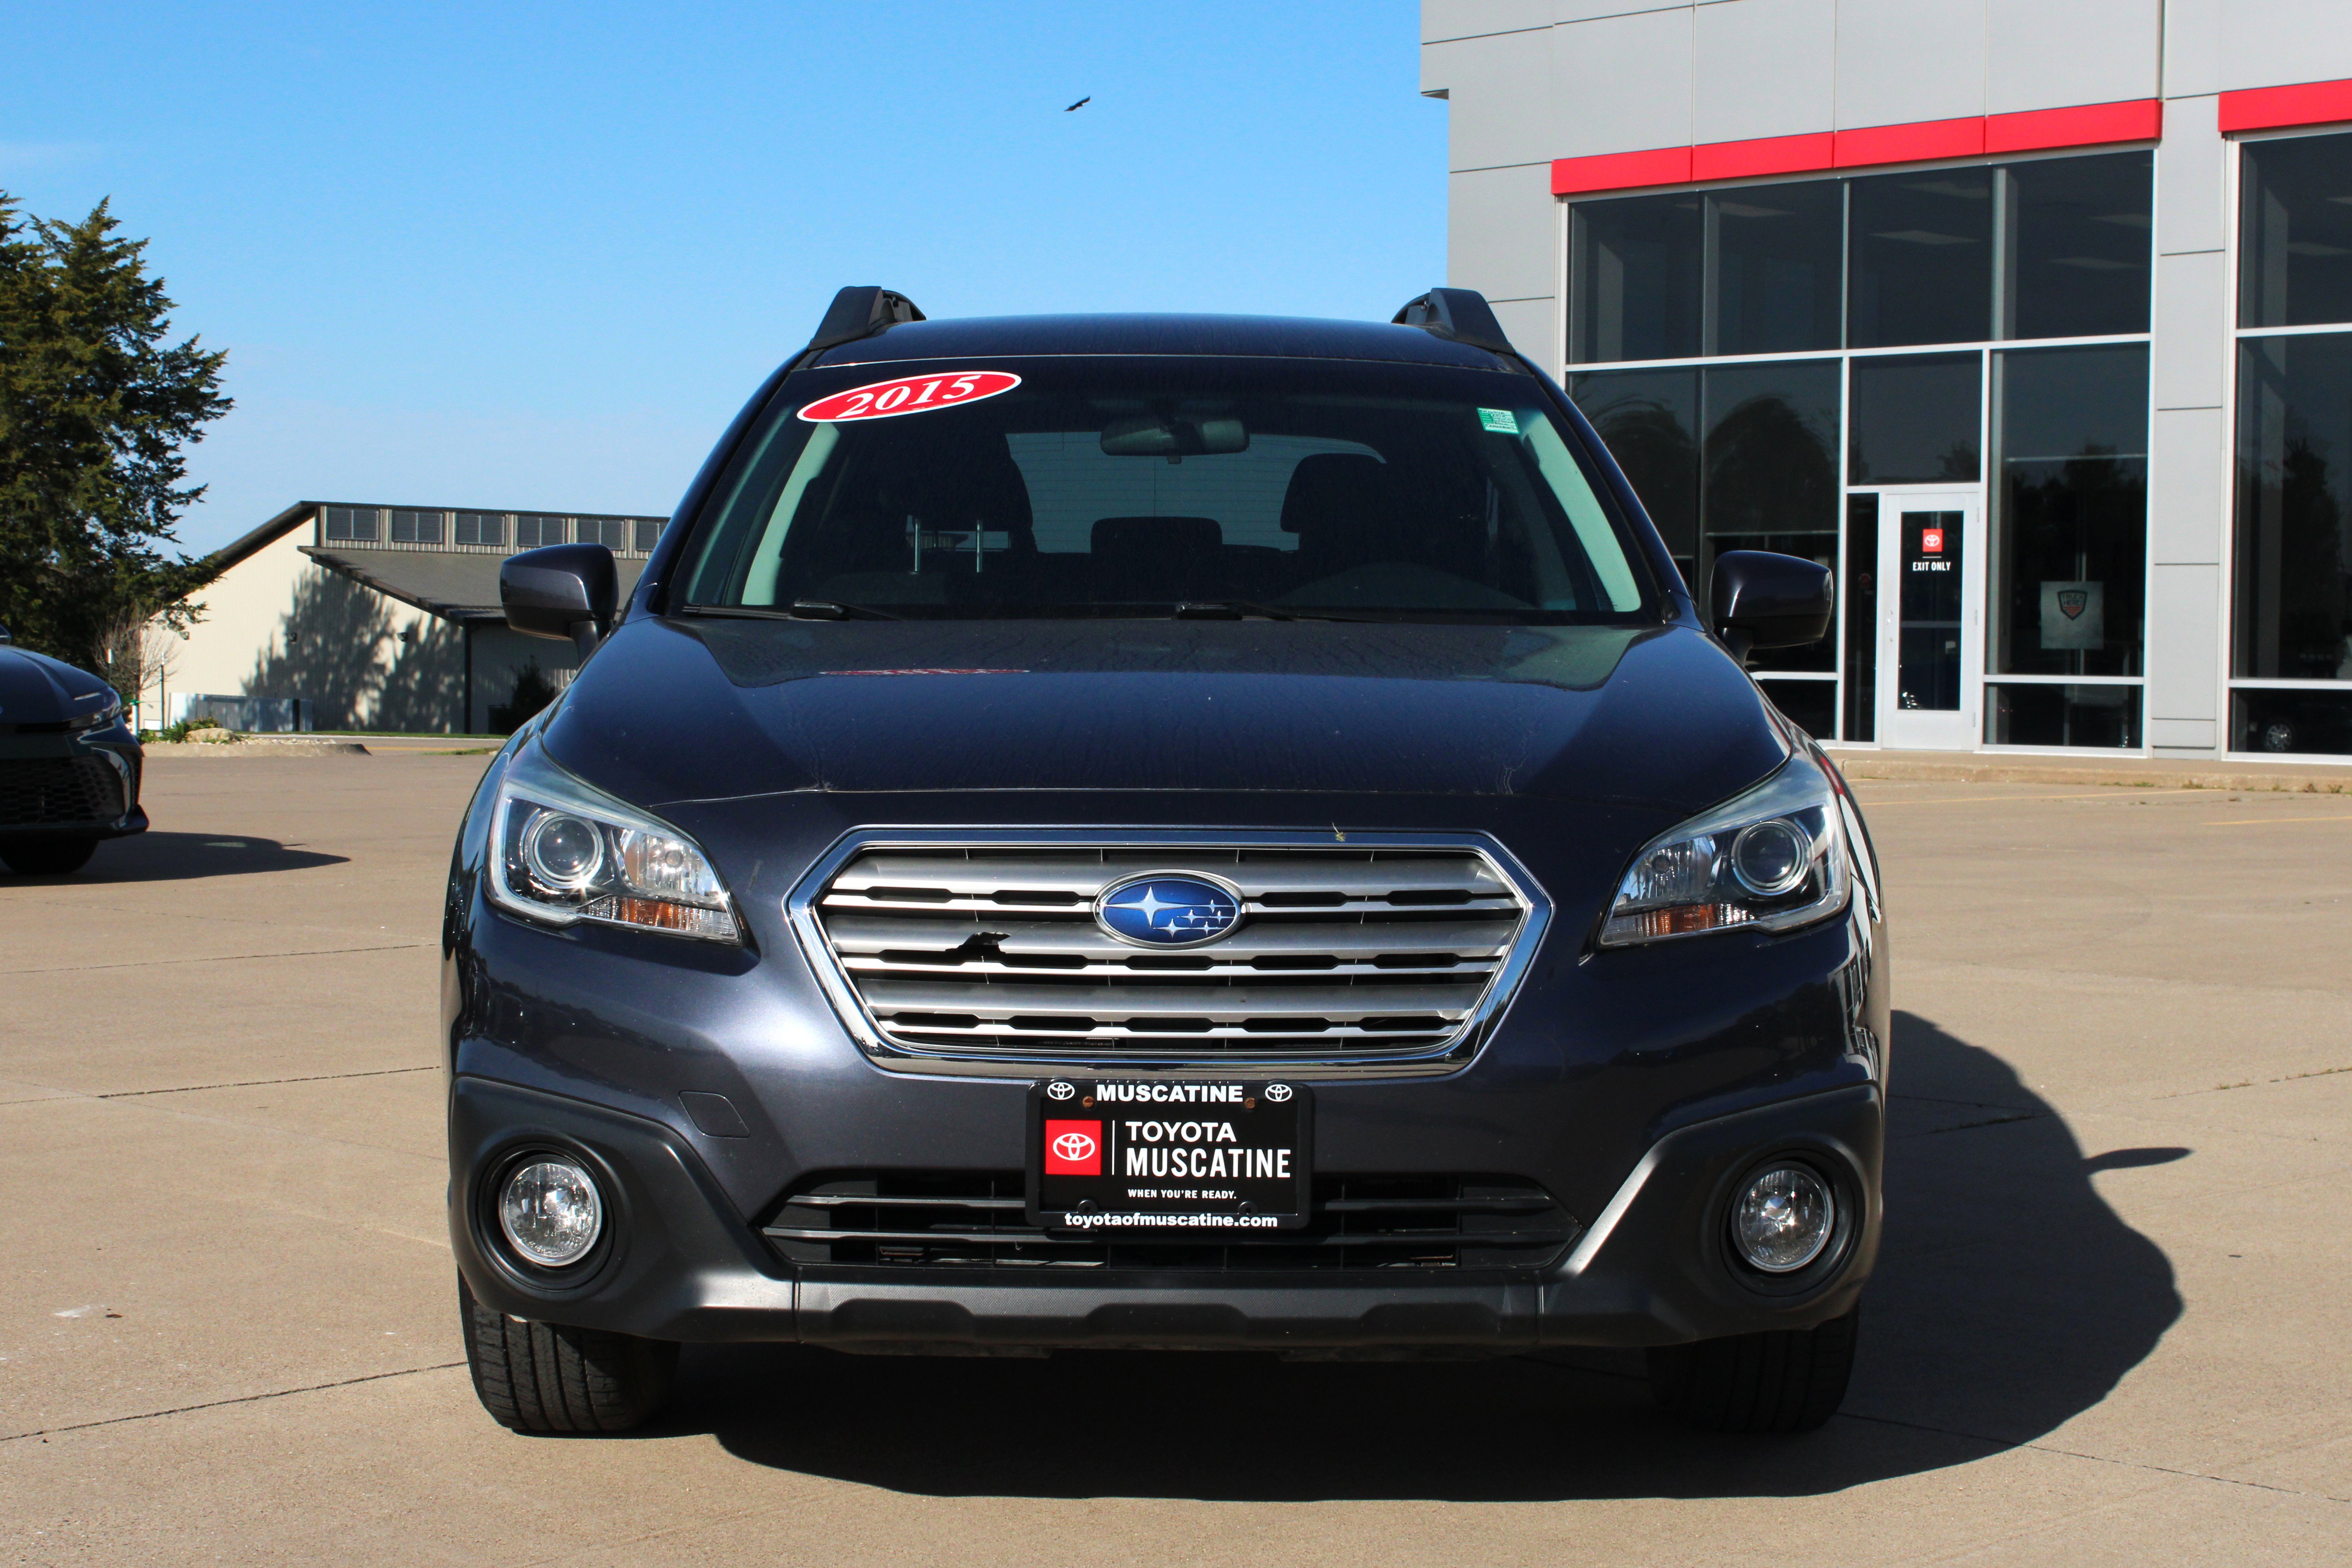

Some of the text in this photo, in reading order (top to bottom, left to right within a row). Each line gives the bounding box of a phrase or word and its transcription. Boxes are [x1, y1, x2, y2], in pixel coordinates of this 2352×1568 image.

[836, 375, 982, 418] 2015
[1913, 561, 1951, 571] EXIT ONLY
[1097, 1084, 1243, 1102] MUSCATINE
[1125, 1121, 1236, 1142] TOYOTA
[1127, 1148, 1290, 1177] MUSCATINE
[1128, 1189, 1236, 1199] WHEN YOU'RE READY.
[1065, 1213, 1277, 1228] toyotaofmuscatine.com
